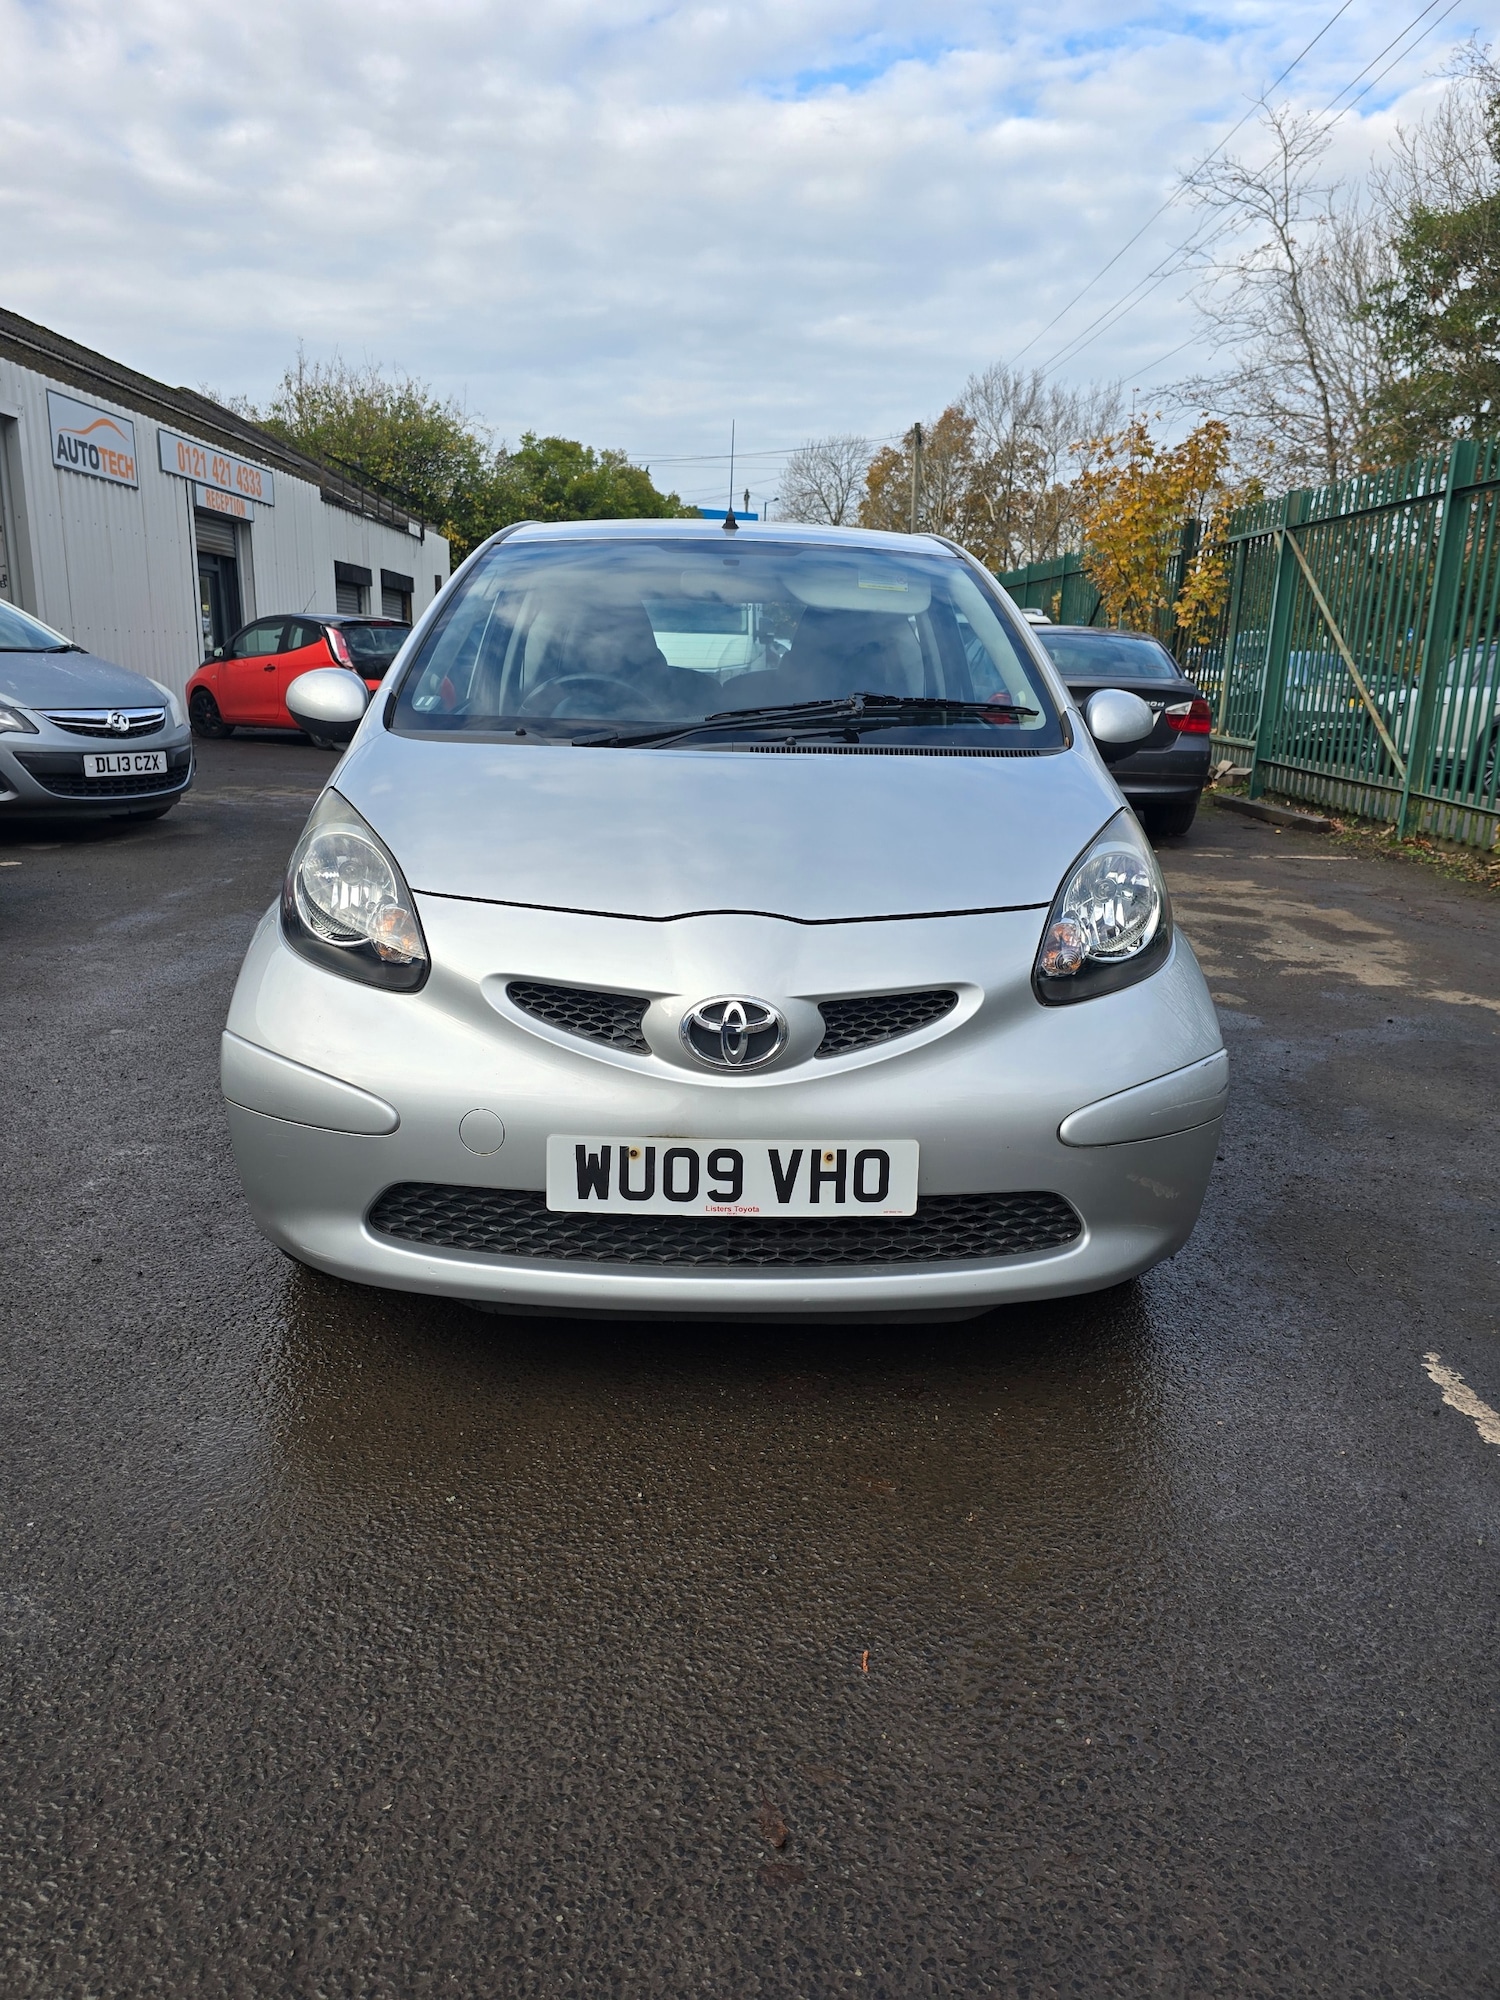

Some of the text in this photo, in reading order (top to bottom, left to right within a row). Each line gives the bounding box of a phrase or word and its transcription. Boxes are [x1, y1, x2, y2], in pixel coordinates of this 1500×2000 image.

[57, 434, 135, 480] AUTOTECH
[177, 441, 262, 497] 0121 421 4333
[205, 489, 246, 517] RECEPTION
[95, 754, 160, 773] DL13 CZX
[575, 1144, 890, 1204] WU09 VHO
